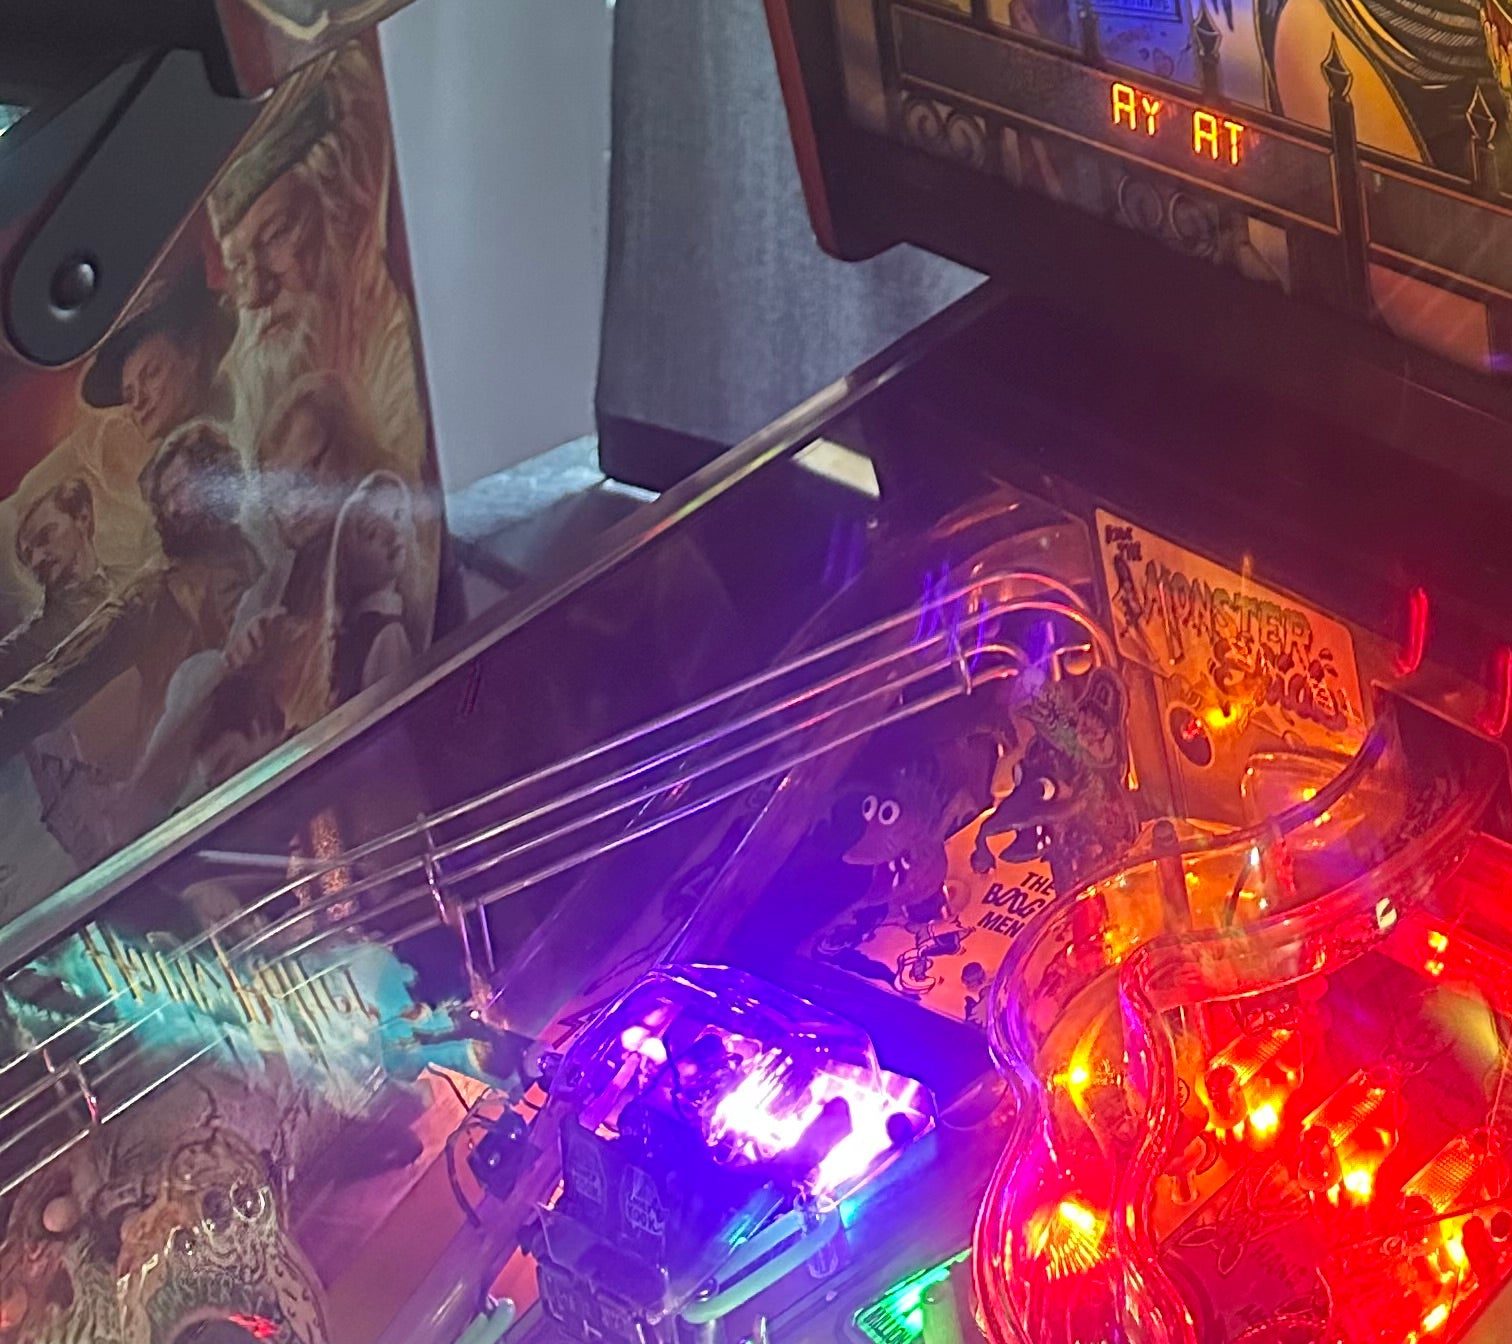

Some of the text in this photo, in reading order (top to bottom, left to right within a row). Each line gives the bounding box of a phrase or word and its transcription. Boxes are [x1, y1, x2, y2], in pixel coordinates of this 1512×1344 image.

[1112, 82, 1245, 166] AY AT
[1020, 871, 1055, 896] THE
[977, 911, 1025, 938] MEN
